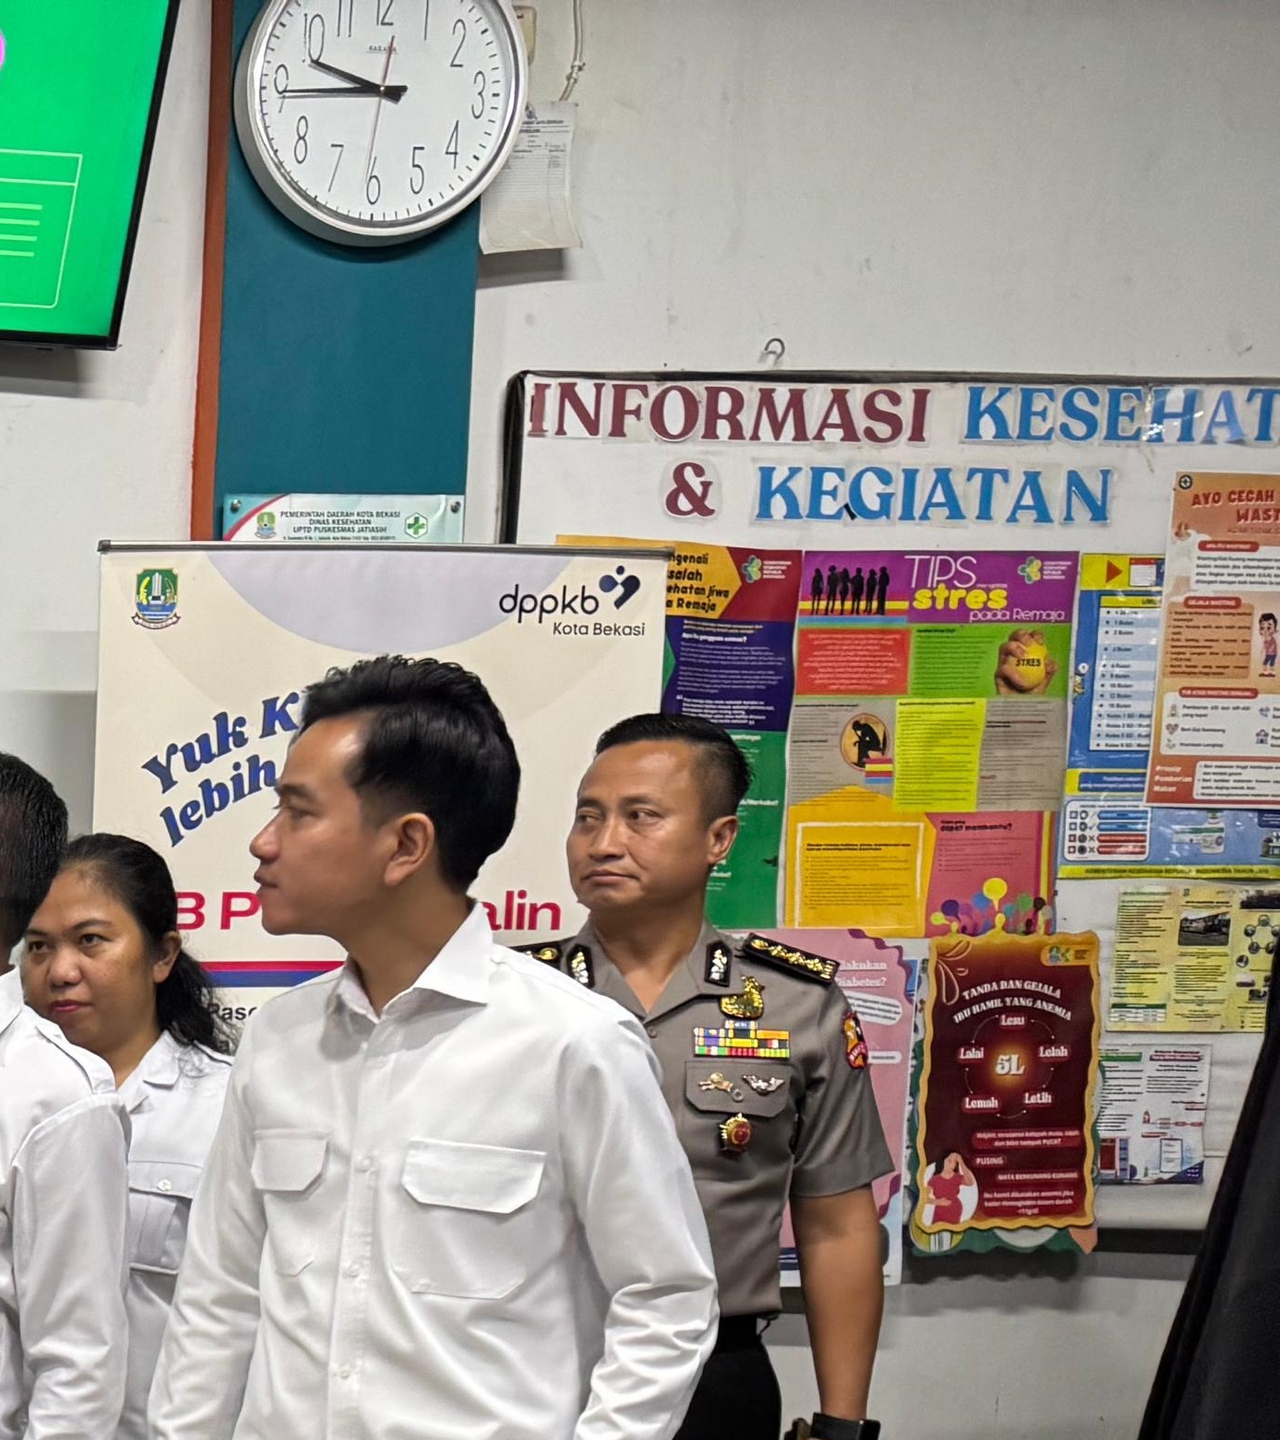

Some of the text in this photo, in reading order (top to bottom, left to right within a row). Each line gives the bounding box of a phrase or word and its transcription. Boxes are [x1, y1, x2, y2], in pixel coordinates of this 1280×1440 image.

[450, 18, 467, 67] 2
[471, 71, 485, 119] 3
[294, 115, 309, 164] 8
[445, 119, 459, 169] 4
[329, 143, 344, 192] 7
[366, 156, 381, 205] 6
[410, 146, 425, 195] 5
[527, 382, 1280, 444] INFORMASI KESEHAT
[666, 461, 1112, 523] & KEGIATAN
[1192, 492, 1222, 508] AYO
[1236, 508, 1280, 523] WAST
[668, 569, 703, 582] salah
[904, 555, 977, 588] TIPS
[667, 584, 705, 596] ehatan
[912, 583, 1008, 609] stres
[498, 583, 600, 624] dppkb
[677, 598, 717, 613] Remaja
[970, 608, 1065, 622] pada Remaja
[552, 621, 646, 636] Kota Bekasi
[1015, 658, 1041, 667] STRES
[140, 691, 301, 795] Yuk K
[158, 752, 279, 847] lebih
[486, 889, 561, 931] alin
[962, 980, 1061, 1001] TANDA DAN GEJALA
[953, 997, 1071, 1024] IBU HAMIL YANG ANEMIA
[1000, 1014, 1024, 1026] Lesu
[996, 1054, 1024, 1074] 5L
[1040, 1046, 1068, 1057] Lelah
[965, 1097, 998, 1108] Lemah
[1025, 1093, 1052, 1104] Letih
[976, 1157, 1003, 1165] PUSING
